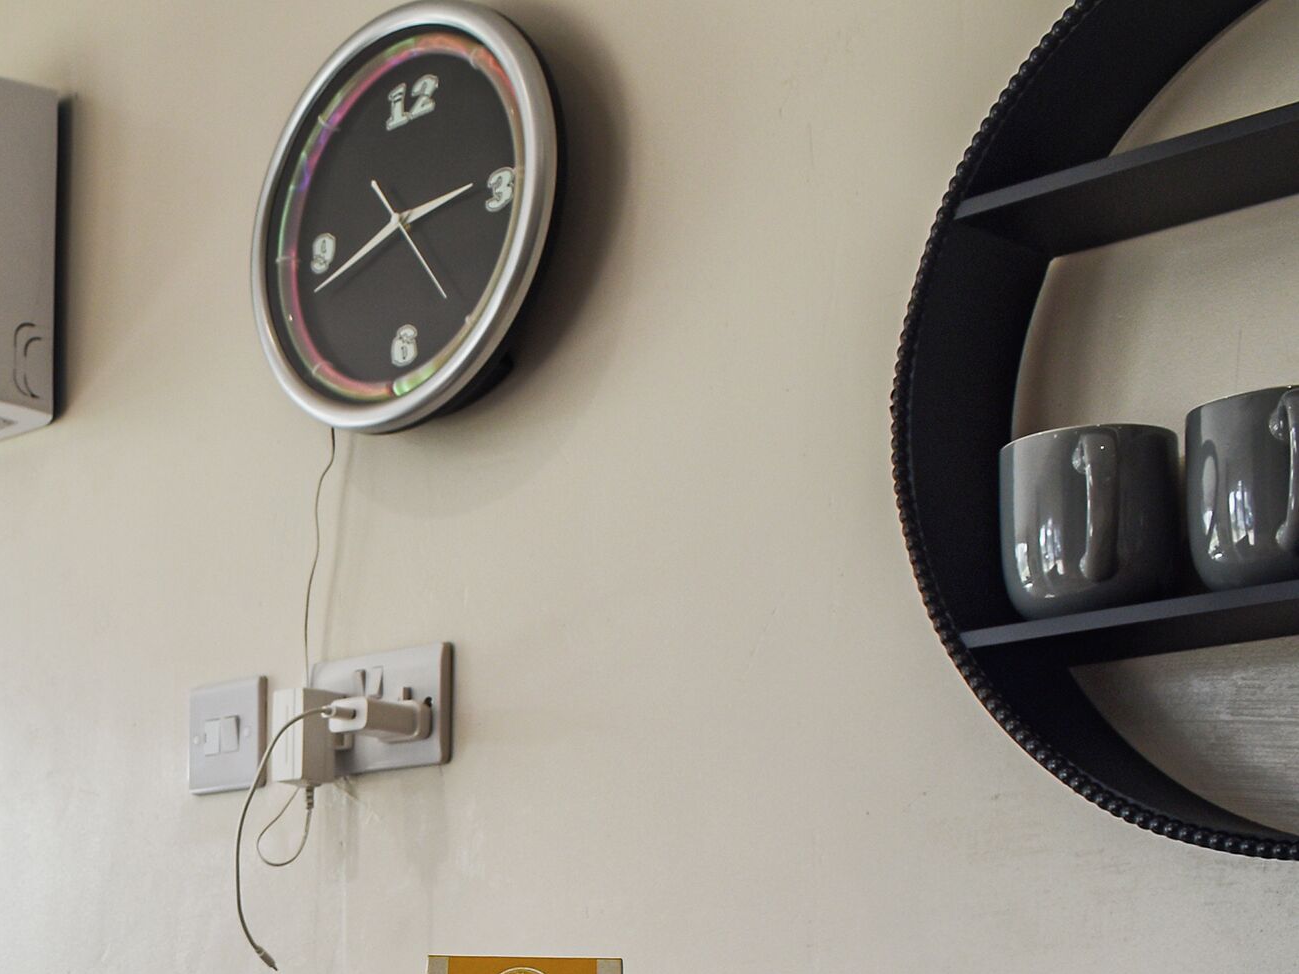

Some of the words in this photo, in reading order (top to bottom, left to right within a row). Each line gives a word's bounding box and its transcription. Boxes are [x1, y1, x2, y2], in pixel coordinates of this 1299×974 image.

[386, 74, 439, 130] 12
[485, 167, 516, 212] 3
[310, 232, 336, 274] 9
[391, 324, 418, 366] 6
